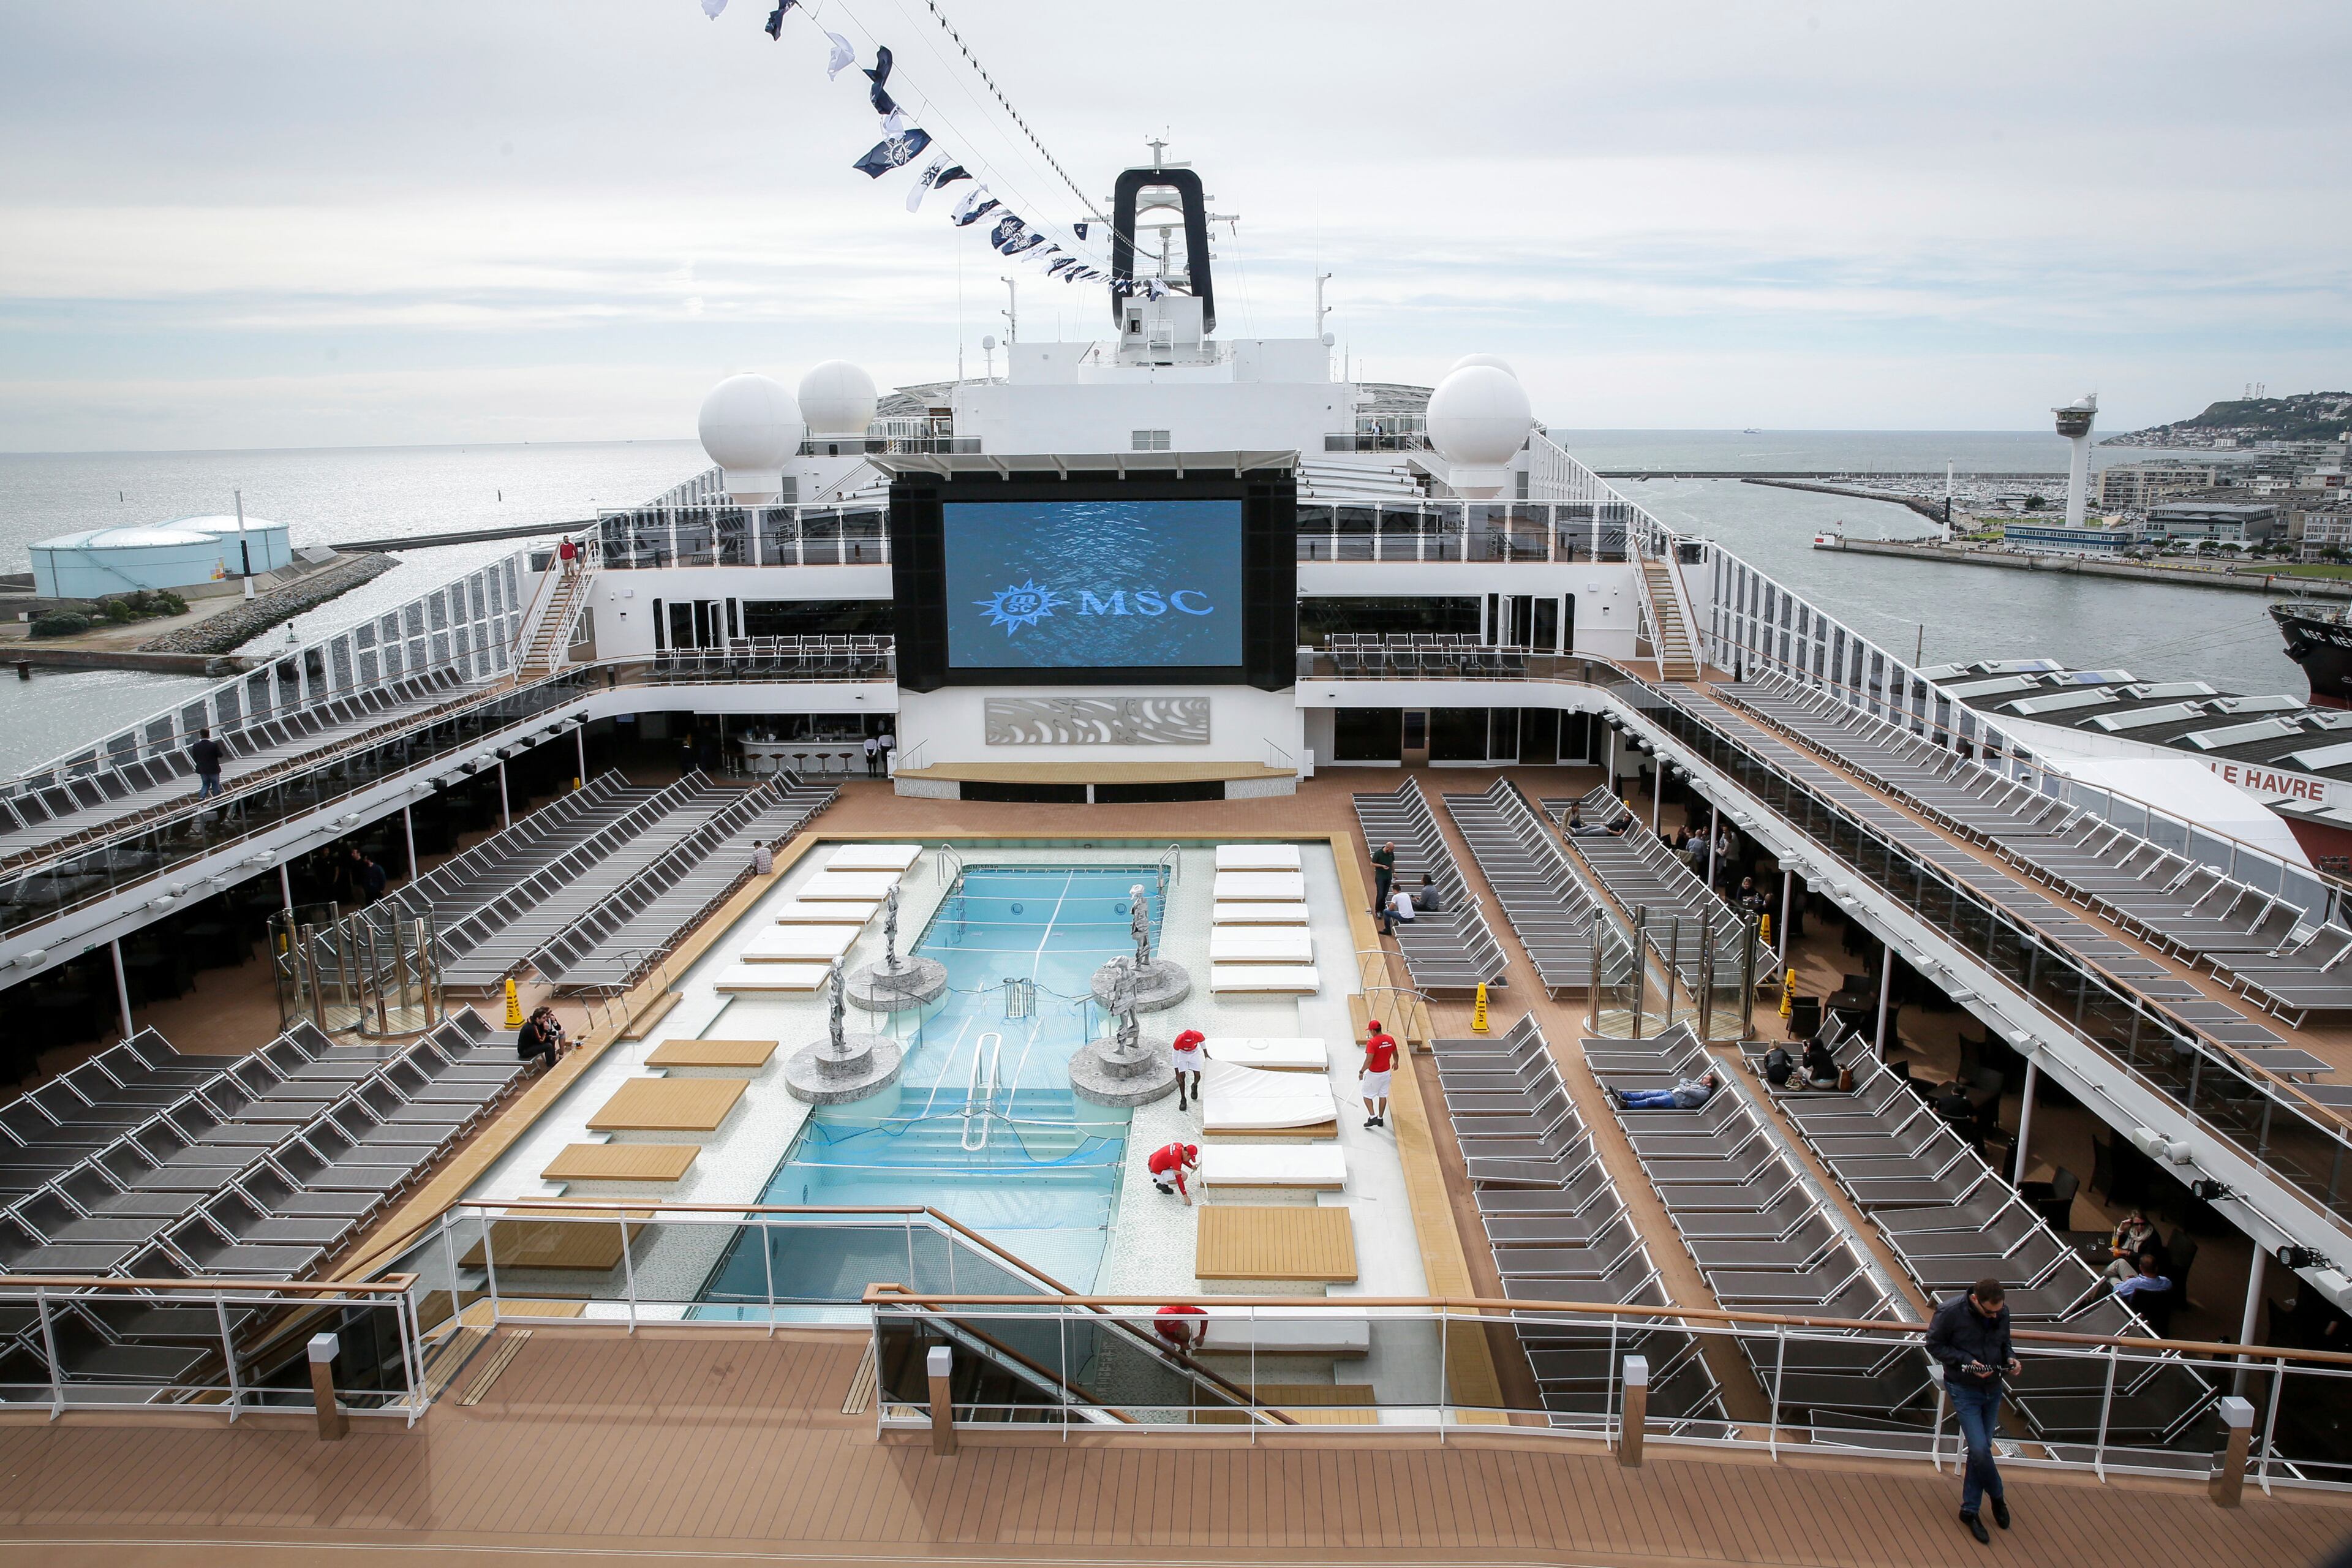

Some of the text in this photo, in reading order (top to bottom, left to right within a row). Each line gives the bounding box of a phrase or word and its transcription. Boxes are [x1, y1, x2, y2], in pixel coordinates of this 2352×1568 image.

[1077, 590, 1213, 616] MSC
[2299, 627, 2326, 641] MSC
[2245, 770, 2324, 801] HAVRE
